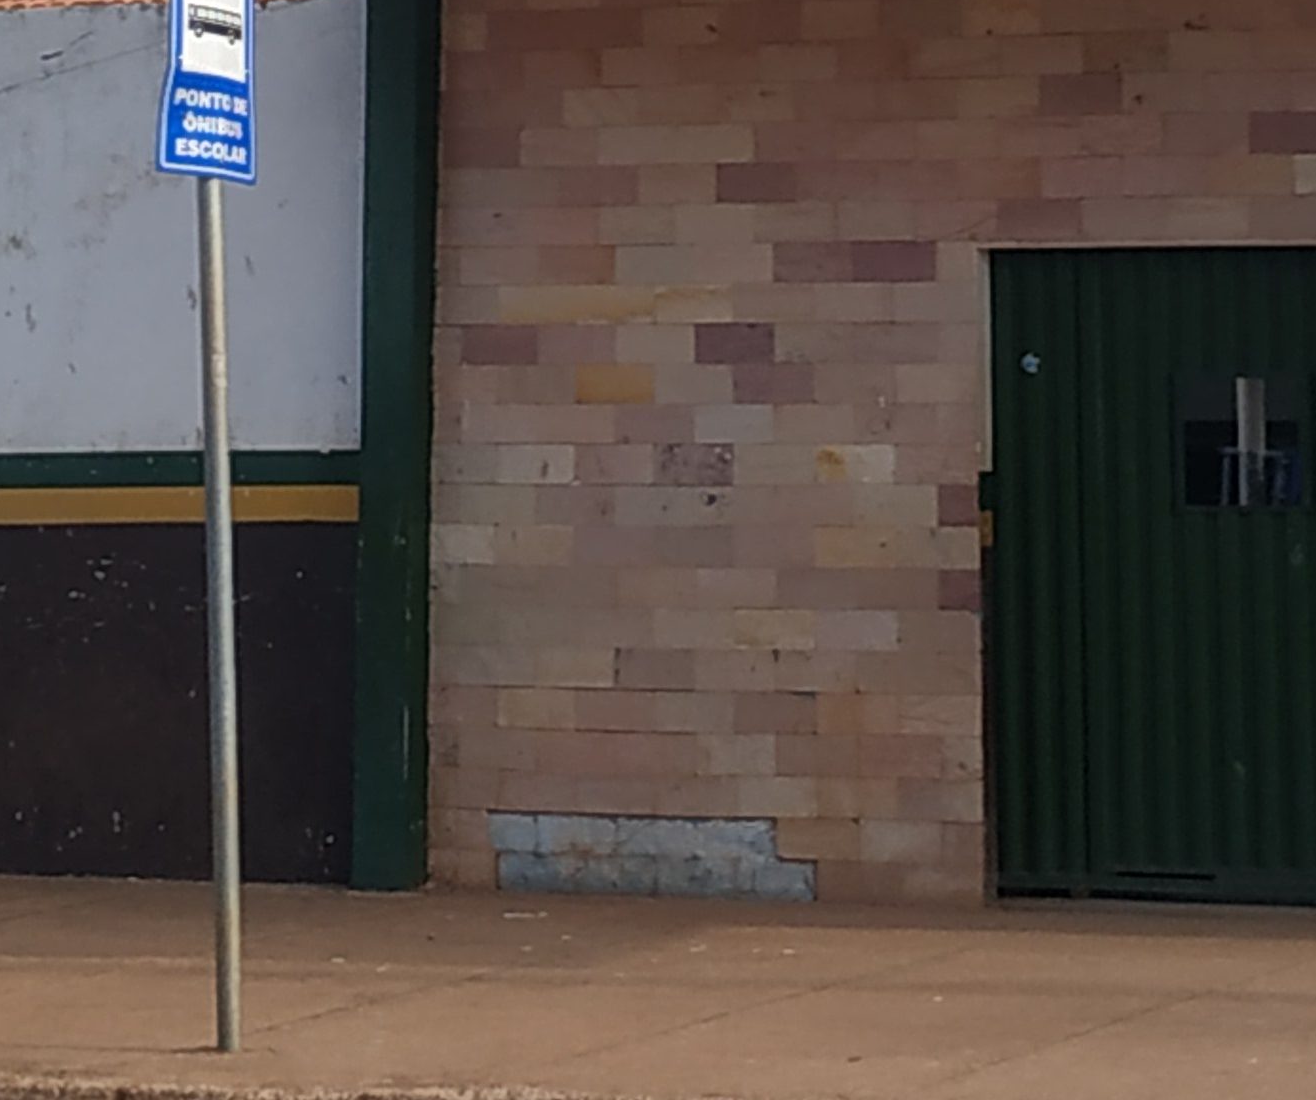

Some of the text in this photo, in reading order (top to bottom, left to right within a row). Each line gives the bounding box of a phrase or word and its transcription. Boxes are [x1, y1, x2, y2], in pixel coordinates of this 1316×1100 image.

[173, 87, 248, 117] PONTO DE
[182, 110, 243, 141] ÔNIBUS
[174, 137, 248, 166] ESCOLAR
